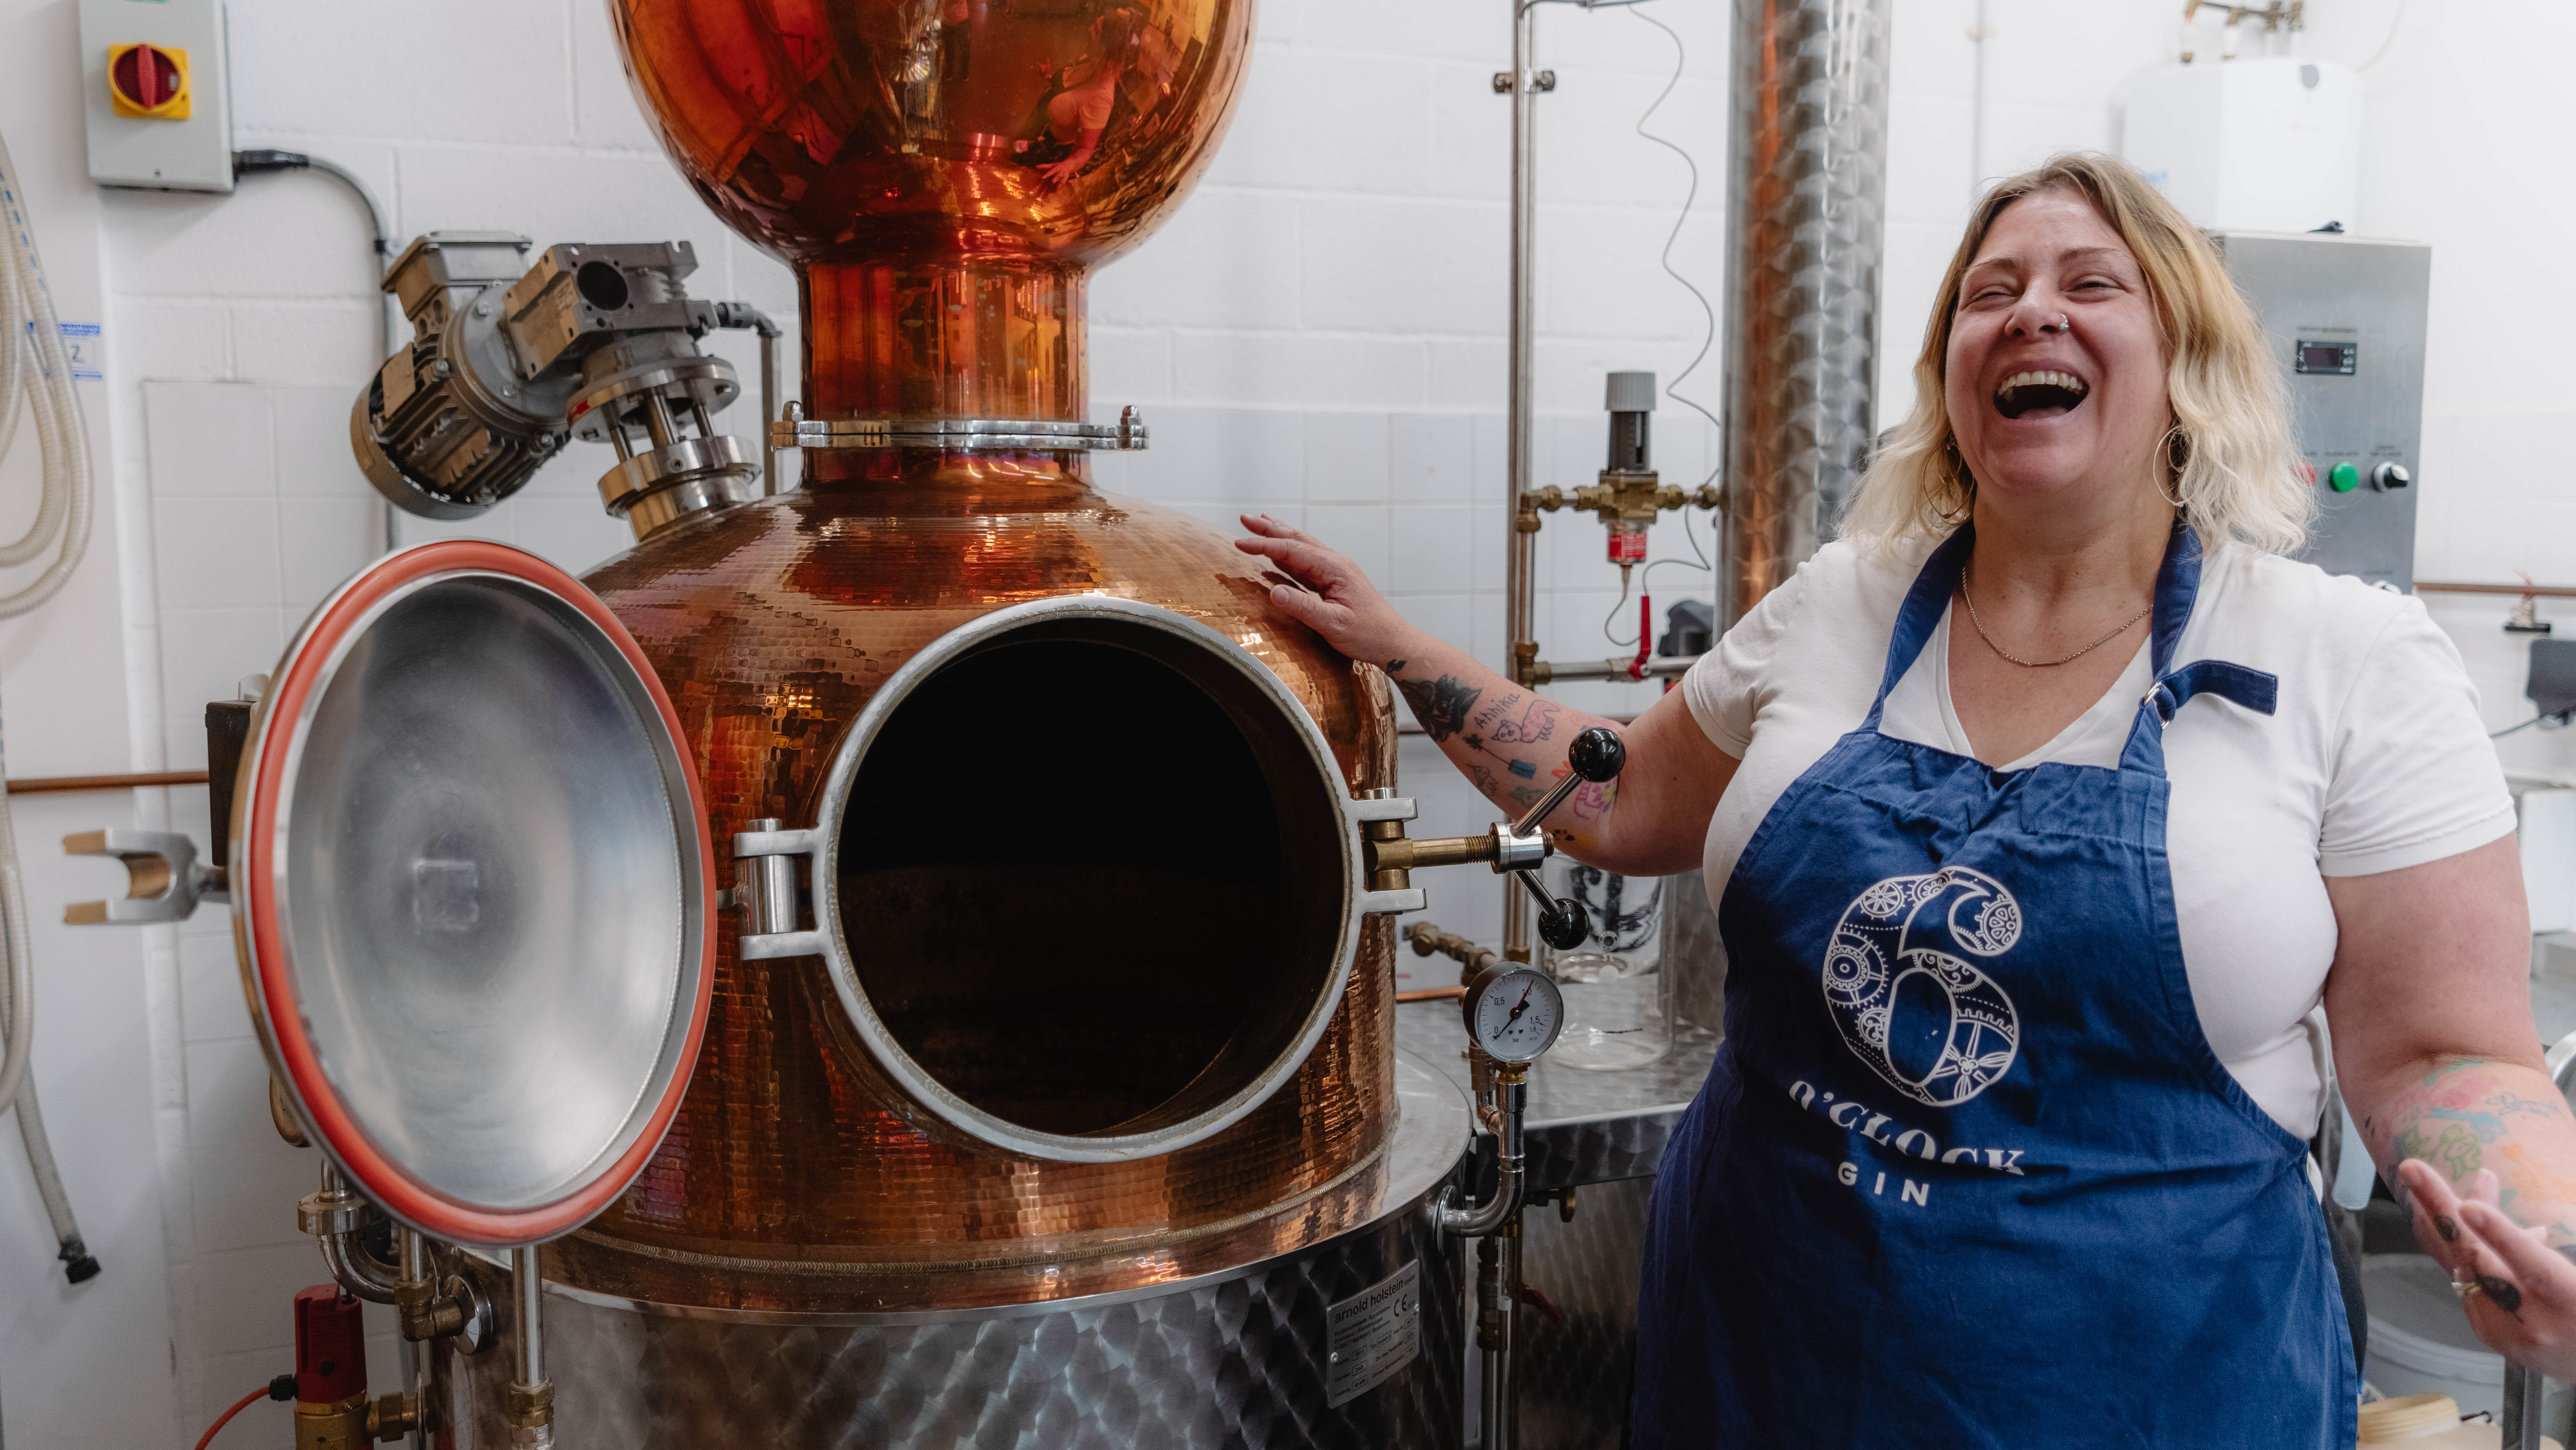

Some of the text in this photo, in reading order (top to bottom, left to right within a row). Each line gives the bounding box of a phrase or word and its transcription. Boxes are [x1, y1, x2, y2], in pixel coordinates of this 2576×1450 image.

[1494, 997, 1505, 1006] 0,5
[1822, 865, 2022, 1107] 6
[1530, 1016, 1539, 1025] 1,5
[1837, 1161, 1930, 1207] GIN
[1335, 1273, 1415, 1324] arnold holstein GmbH
